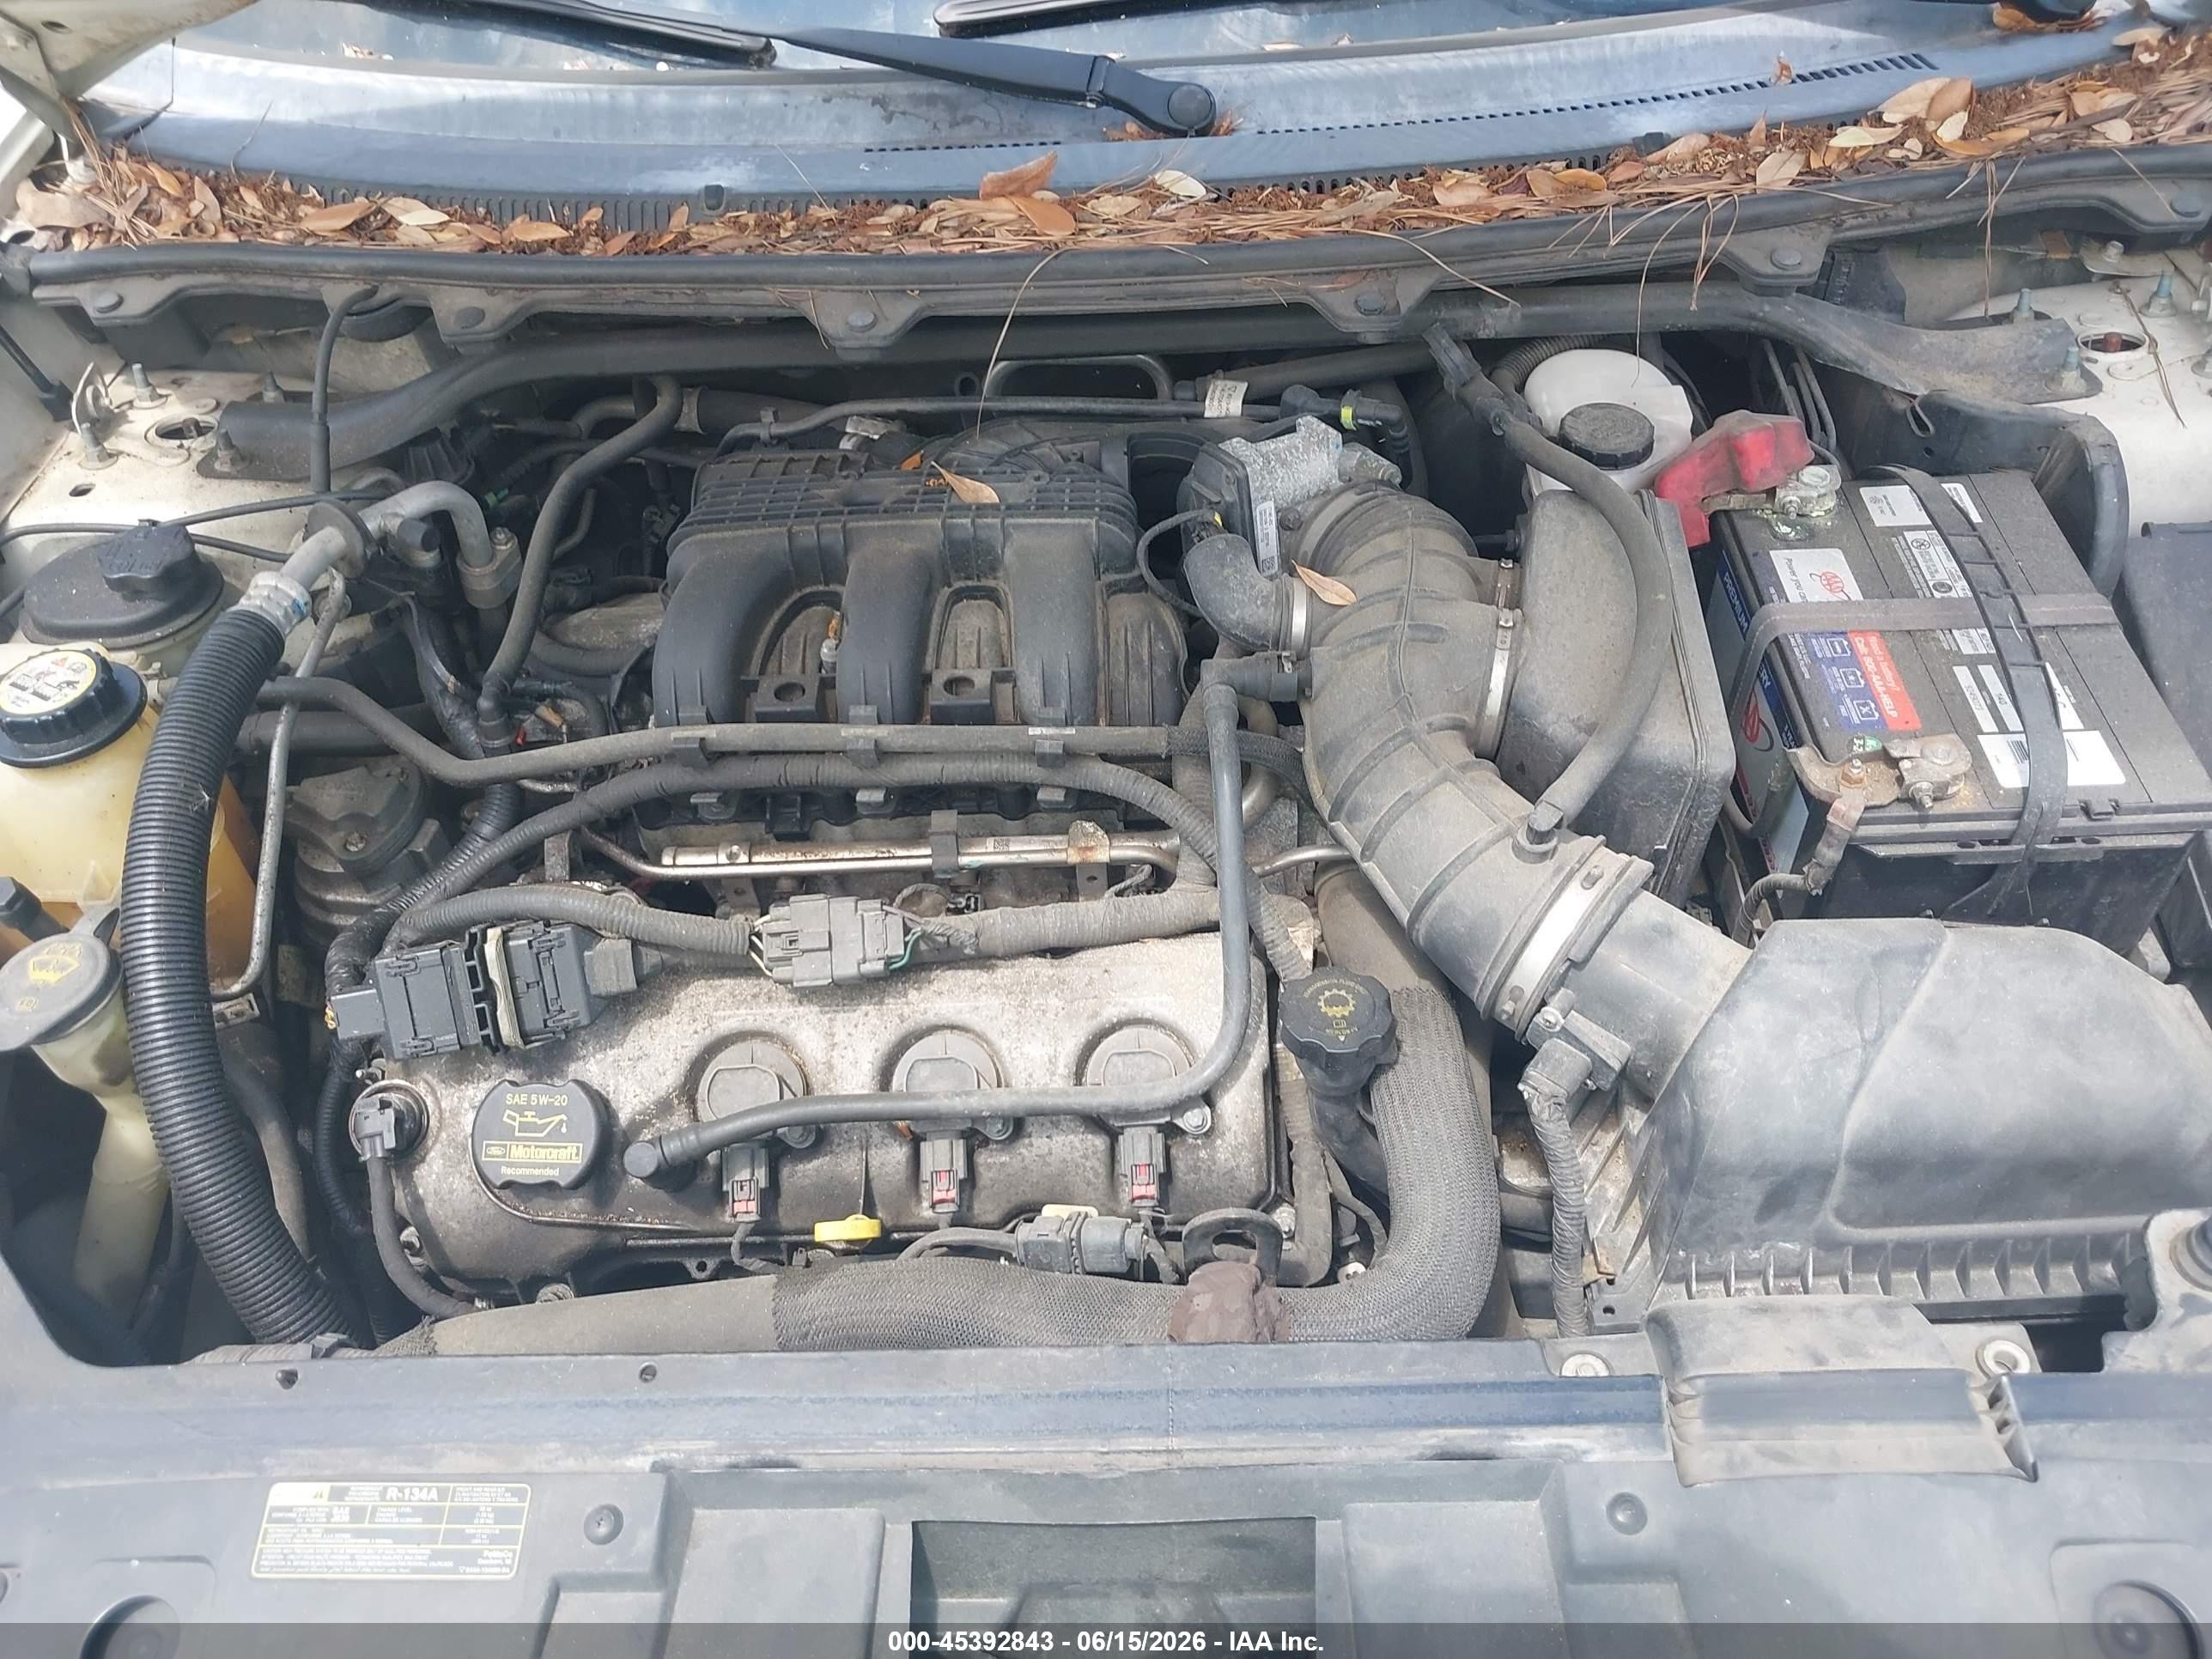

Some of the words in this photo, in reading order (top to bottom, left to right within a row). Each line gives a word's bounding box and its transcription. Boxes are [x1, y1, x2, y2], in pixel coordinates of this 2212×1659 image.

[1784, 556, 1798, 581] Power
[1723, 570, 1748, 634] PREMIUM
[505, 1093, 527, 1105] SAE
[531, 1094, 568, 1106] 5W-20
[510, 1144, 578, 1161] Motorcraft
[501, 1165, 560, 1176] Recommended
[386, 1486, 439, 1501] R-134A
